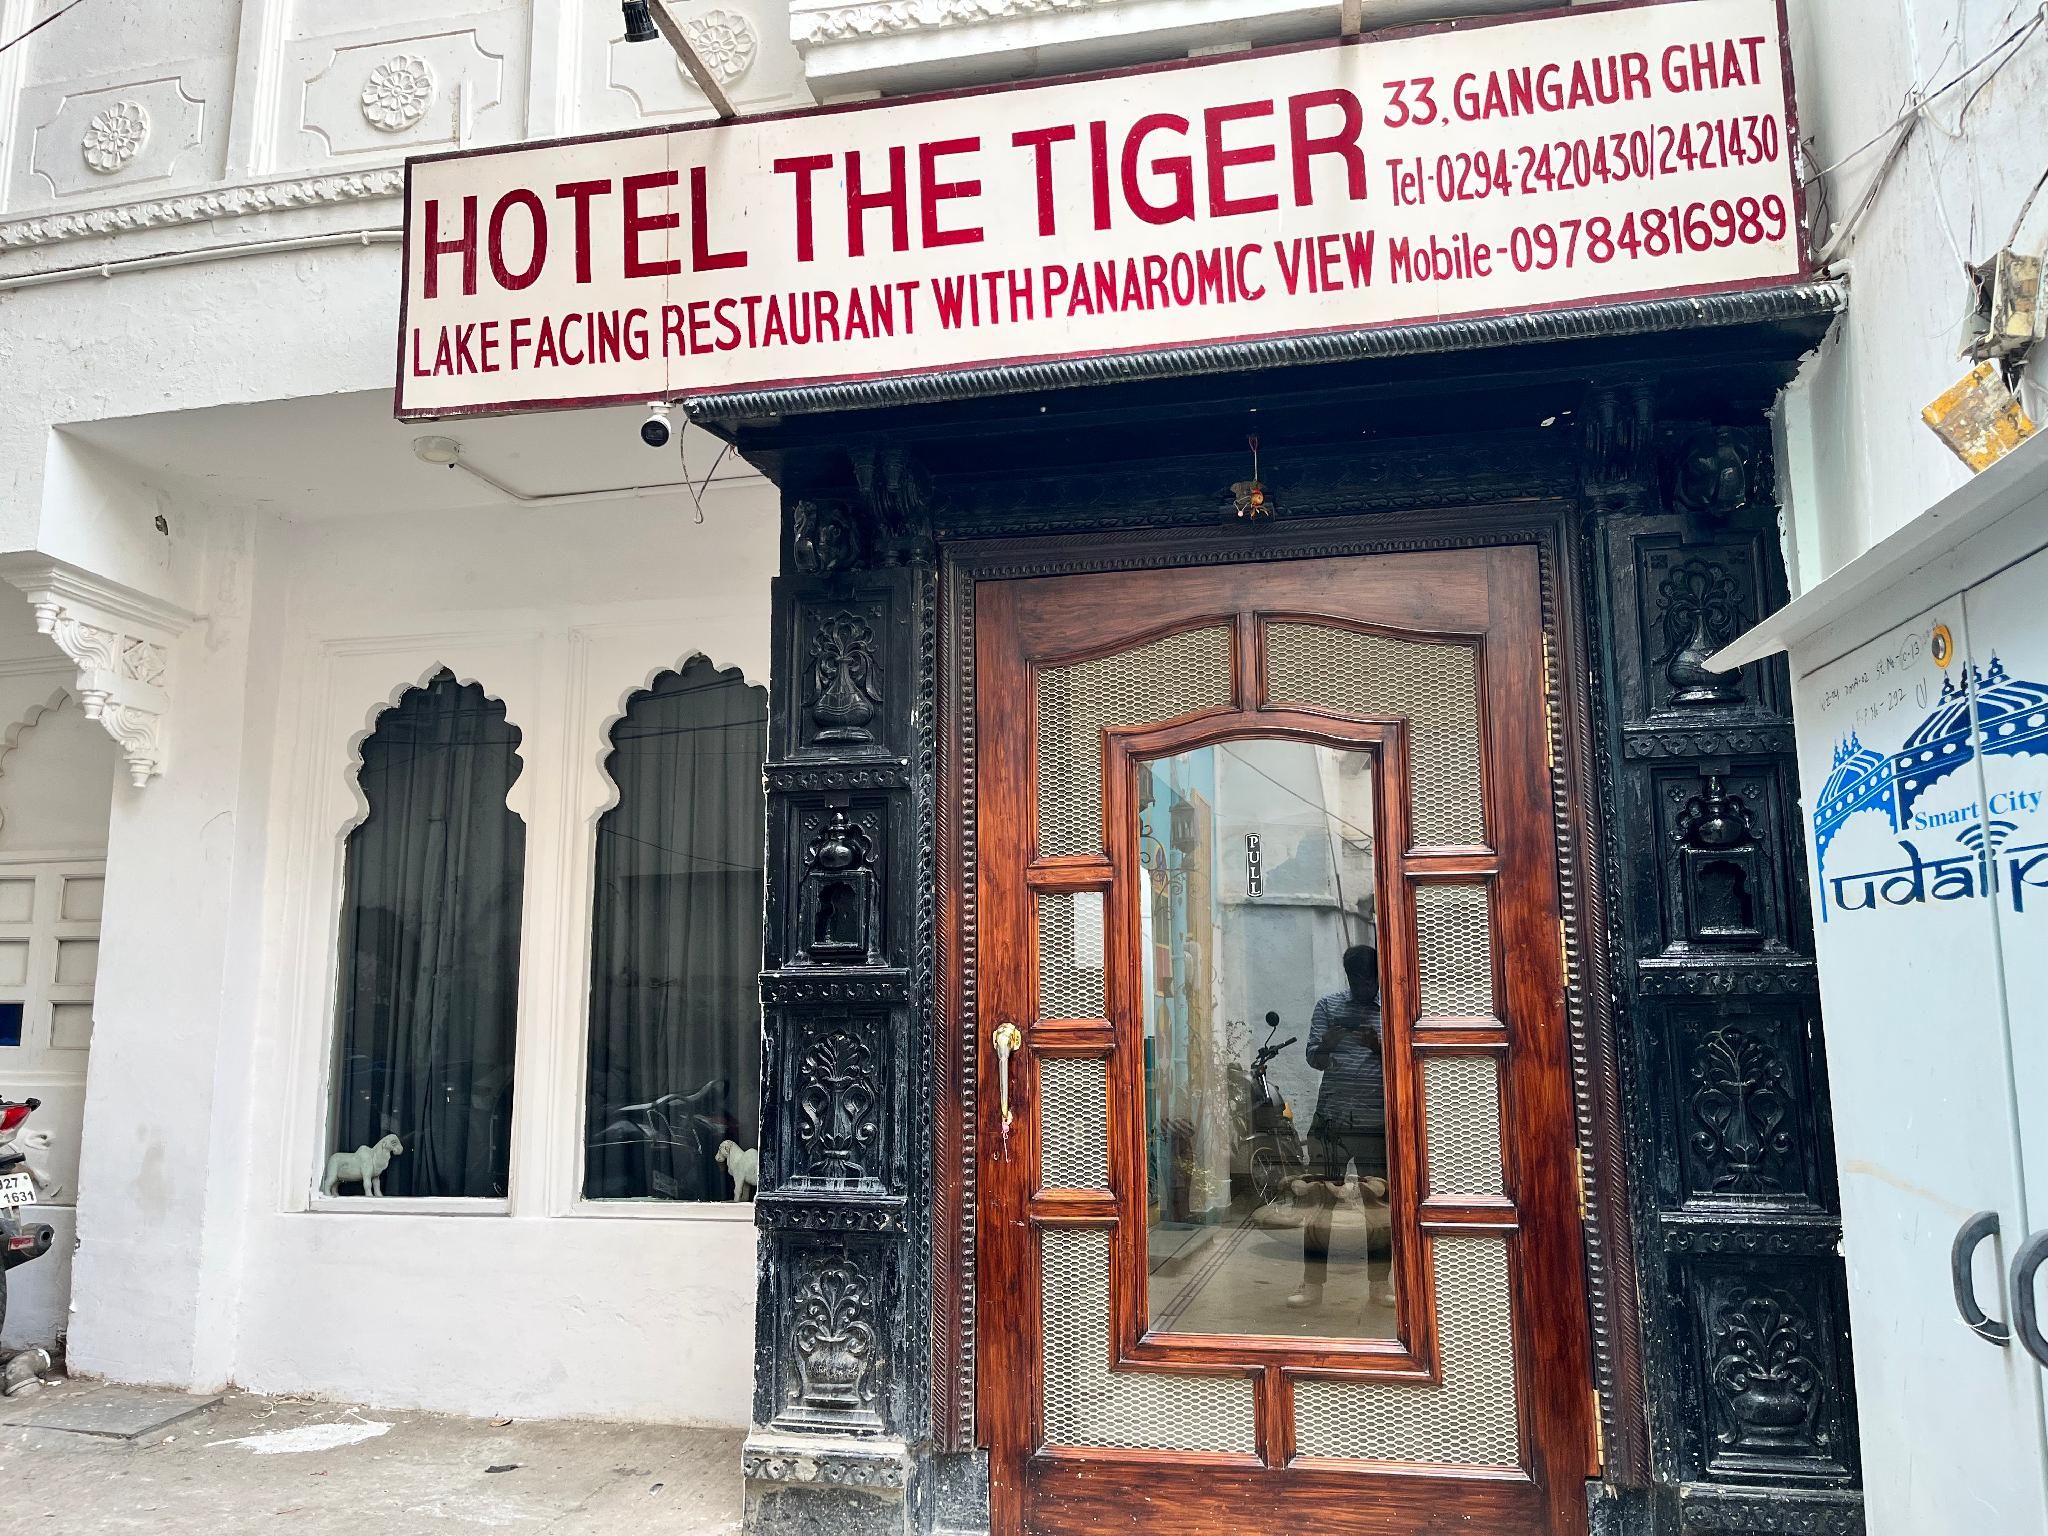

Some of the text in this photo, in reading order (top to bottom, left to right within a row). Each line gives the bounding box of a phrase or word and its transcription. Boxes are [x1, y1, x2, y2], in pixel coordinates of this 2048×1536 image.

[1662, 37, 1766, 93] GHAT
[424, 89, 1368, 299] HOTEL THE TIGER
[413, 230, 1375, 377] LAKE FACING RESTAURANT WITH PANAROMIC VIEW
[1914, 790, 2043, 830] Smart City
[1248, 836, 1261, 894] PULL
